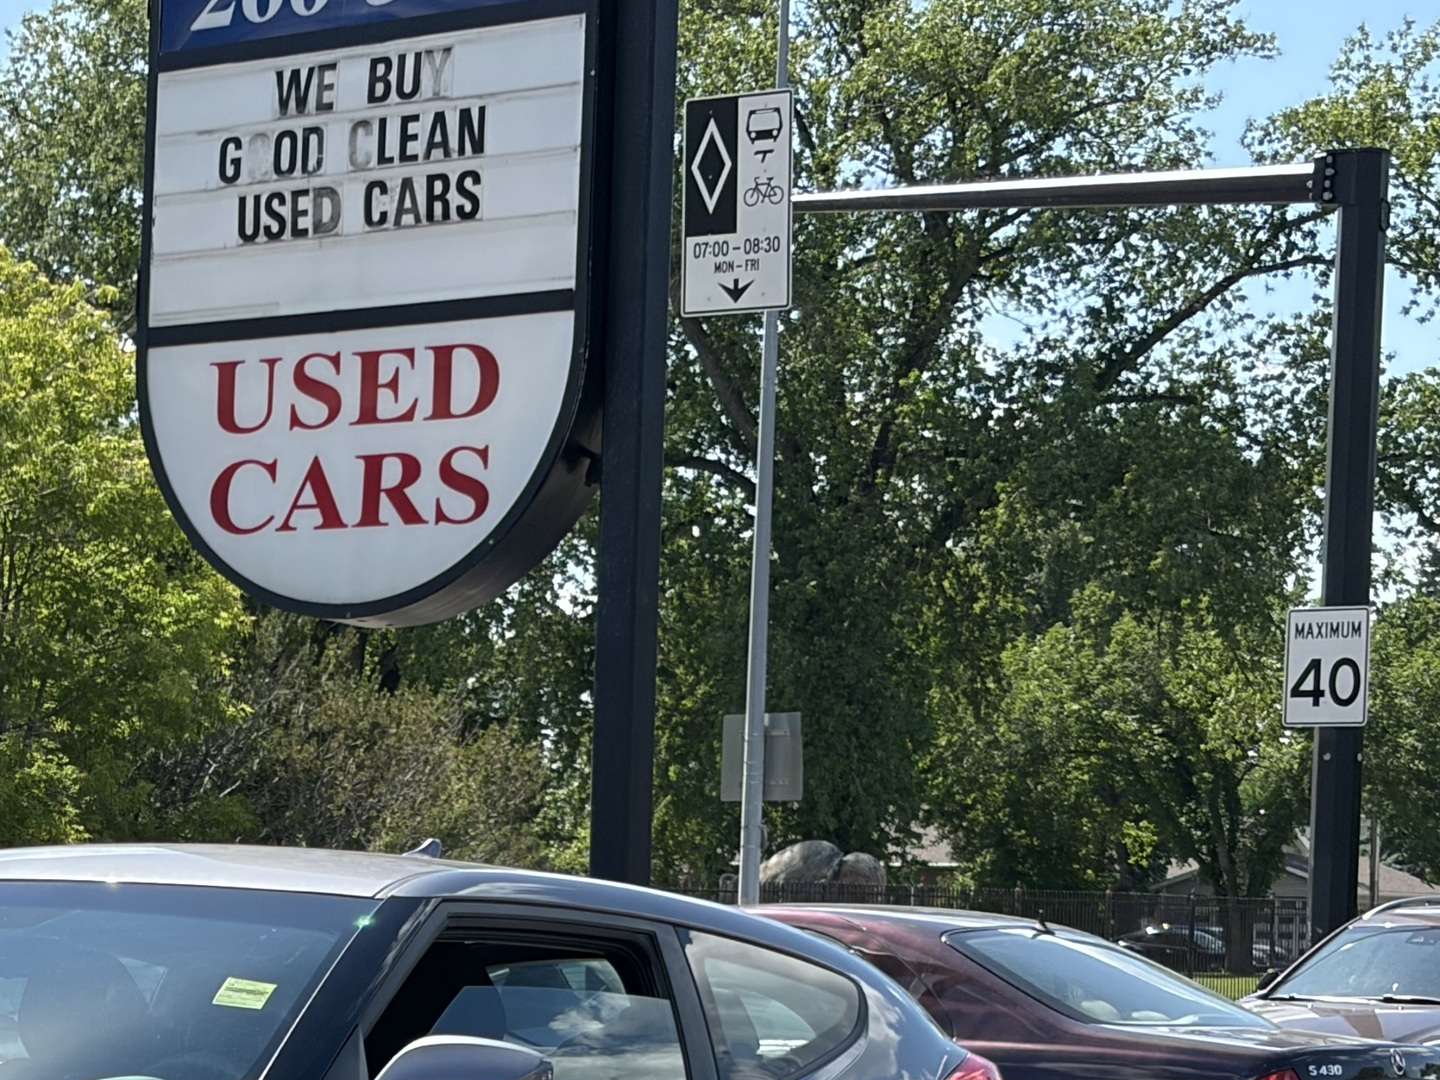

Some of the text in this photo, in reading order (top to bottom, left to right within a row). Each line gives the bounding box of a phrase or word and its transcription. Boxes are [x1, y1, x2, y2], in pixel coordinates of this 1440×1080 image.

[276, 47, 453, 117] WE BUY
[349, 105, 487, 170] CLEAN
[237, 170, 481, 243] USED CARS
[693, 240, 730, 260] 07:00
[743, 235, 781, 255] 08:30
[210, 343, 501, 435] USED
[209, 445, 491, 536] CARS
[1294, 621, 1362, 640] MAXIMUM
[1290, 657, 1361, 707] 40
[1319, 1064, 1343, 1076] 430
